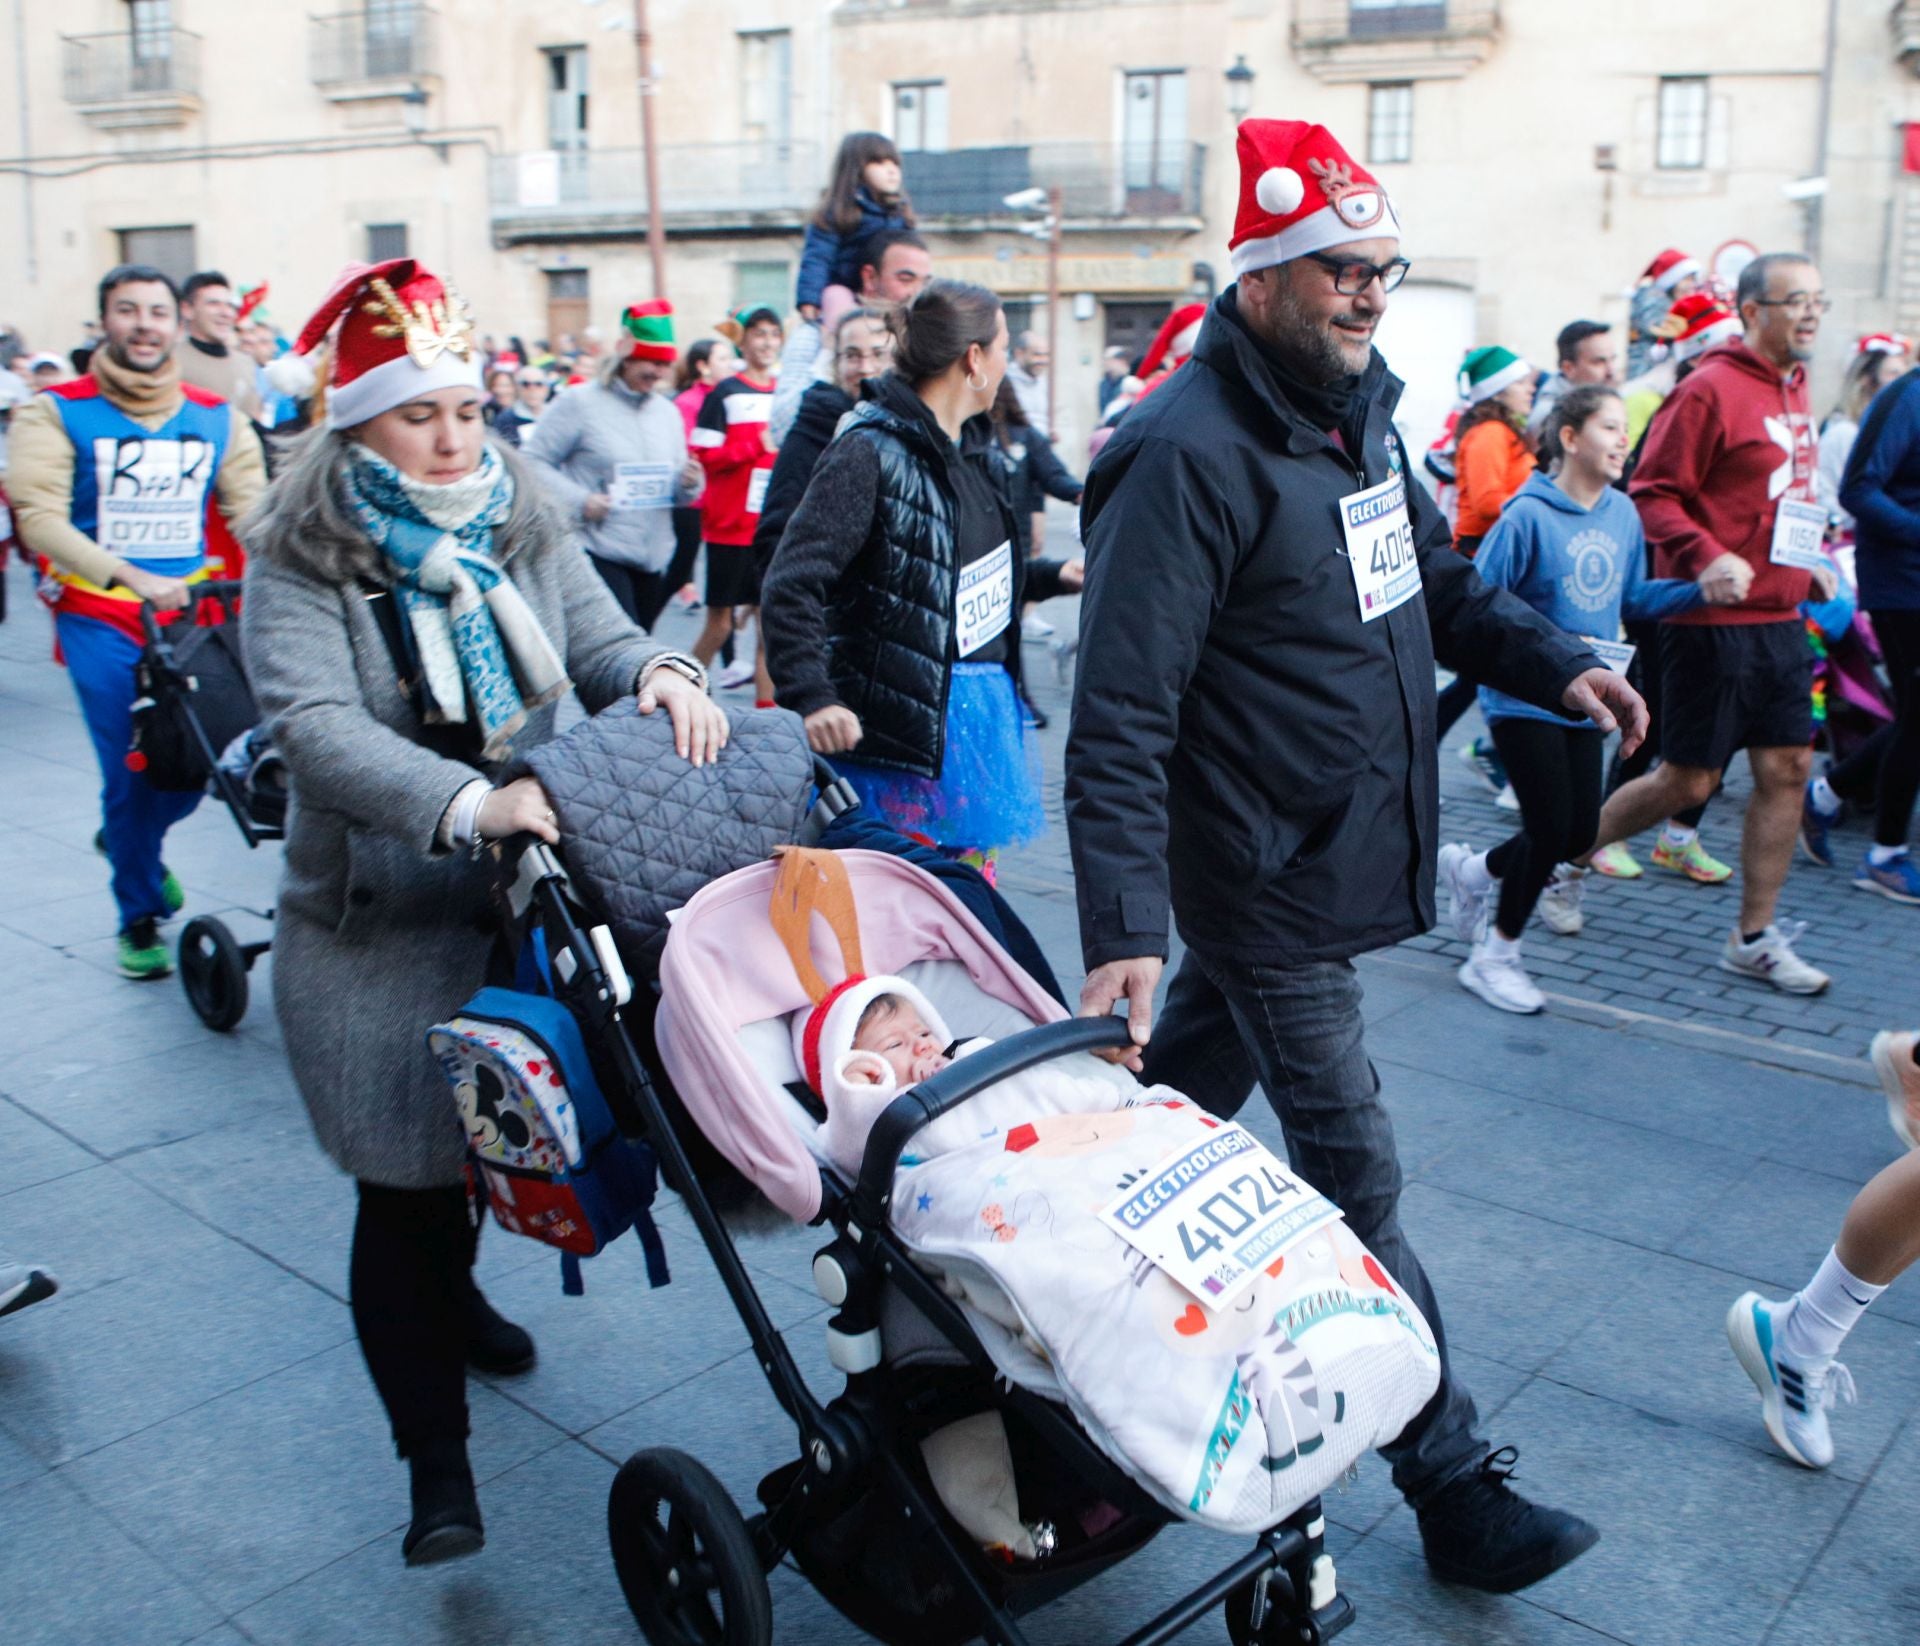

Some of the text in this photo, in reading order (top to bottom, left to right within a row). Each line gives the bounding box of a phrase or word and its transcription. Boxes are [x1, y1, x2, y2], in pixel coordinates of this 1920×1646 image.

[112, 520, 191, 541] 0705
[1370, 522, 1415, 577] 4015
[1788, 526, 1818, 551] 1150
[961, 576, 1010, 629] 3043
[1121, 1129, 1252, 1227] ELECTROCASH
[1176, 1166, 1302, 1263] 4024
